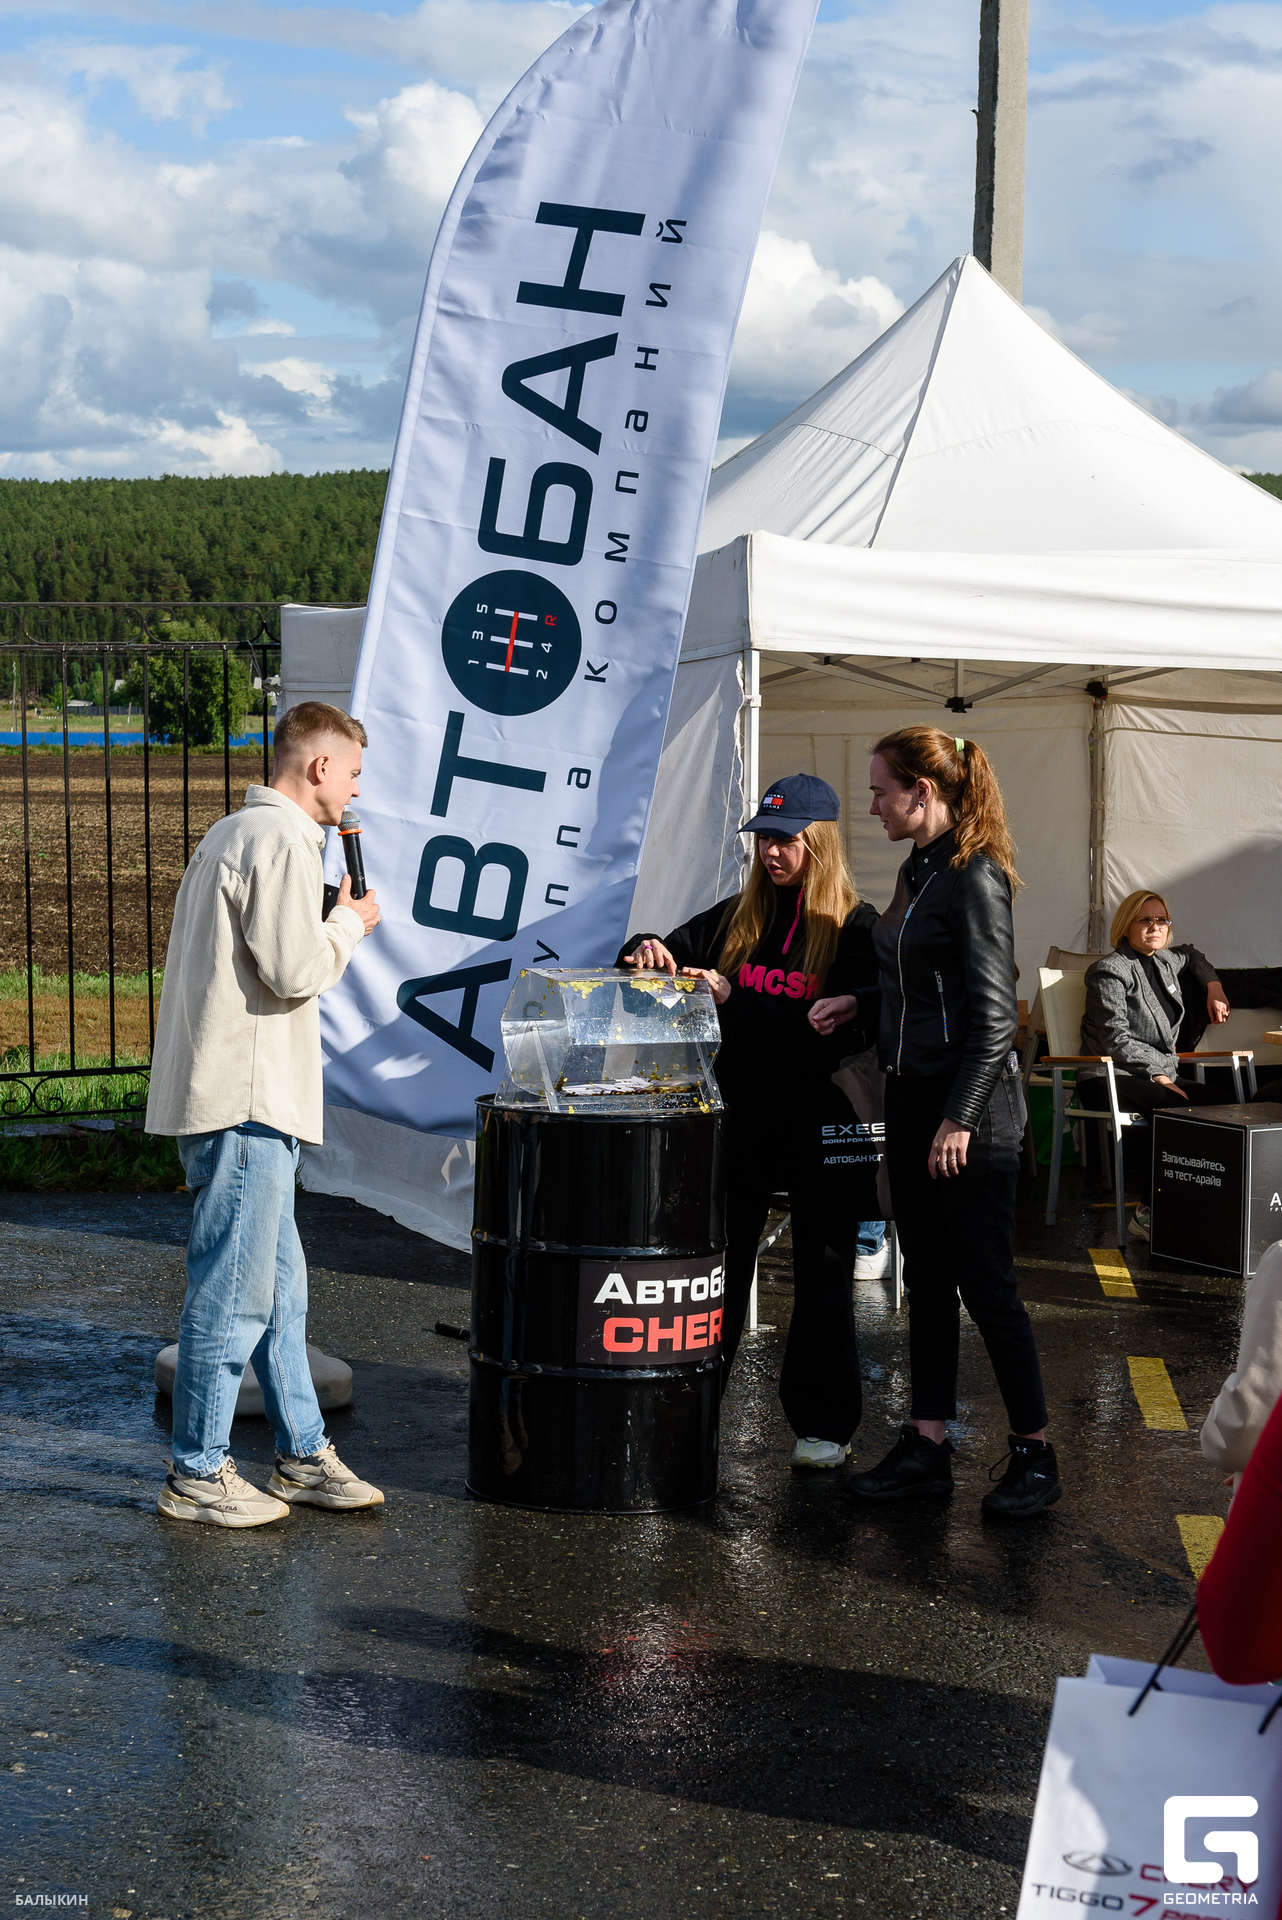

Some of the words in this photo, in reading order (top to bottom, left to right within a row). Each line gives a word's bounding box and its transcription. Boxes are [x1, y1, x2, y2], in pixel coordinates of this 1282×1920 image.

[583, 218, 688, 684] компаний
[476, 603, 489, 614] 5
[544, 614, 557, 627] R
[396, 201, 646, 1074] АВТОБАН
[471, 630, 484, 641] 3
[540, 642, 553, 654] 4
[535, 669, 549, 680] 2
[823, 1154, 868, 1165] АВТОБАН
[1162, 1151, 1226, 1172] Записывайтесь
[1164, 1169, 1174, 1179] на
[1175, 1170, 1222, 1187] тест-драйв
[1032, 1882, 1125, 1912] TIGGO
[1128, 1893, 1159, 1918] 7
